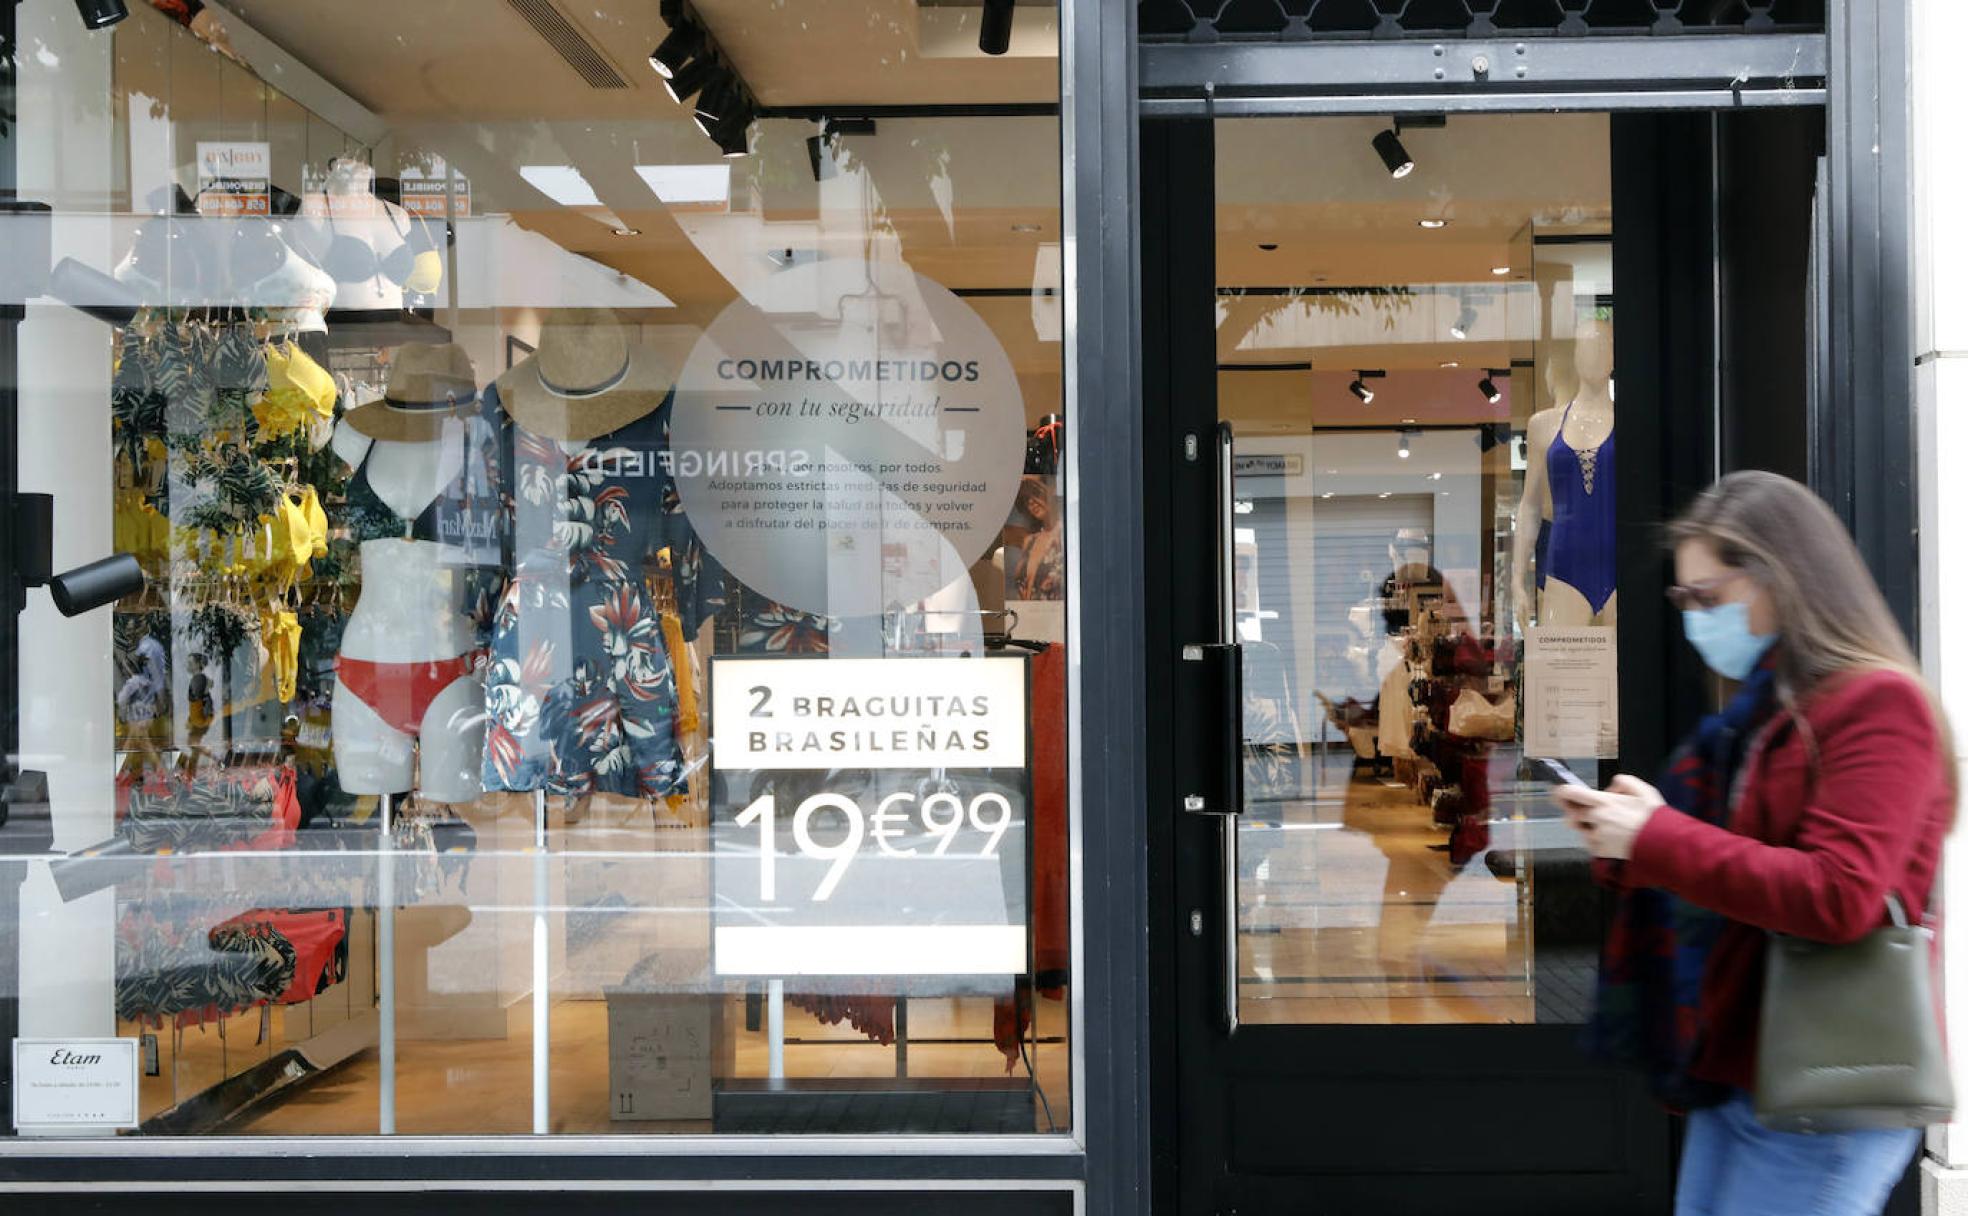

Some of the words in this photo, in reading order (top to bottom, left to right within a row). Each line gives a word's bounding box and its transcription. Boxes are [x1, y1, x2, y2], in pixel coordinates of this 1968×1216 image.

[717, 359, 980, 382] COMPROMETIDOS
[756, 401, 792, 417] con
[799, 397, 823, 417] tu
[828, 396, 941, 425] seguridad
[879, 463, 901, 474] por
[708, 480, 784, 494] Adoptamos
[786, 480, 840, 492] estrictas
[902, 481, 920, 492] de
[923, 481, 987, 495] seguridad
[721, 501, 750, 513] para
[754, 500, 809, 513] proteger
[812, 499, 824, 511] la
[936, 500, 975, 512] volver
[736, 518, 790, 530] disfrutar
[794, 518, 814, 530] del
[748, 685, 773, 718] 2
[792, 696, 990, 717] BRAGUITAS
[749, 724, 991, 752] BRASILEÑAS
[50, 1048, 102, 1065] Etam
